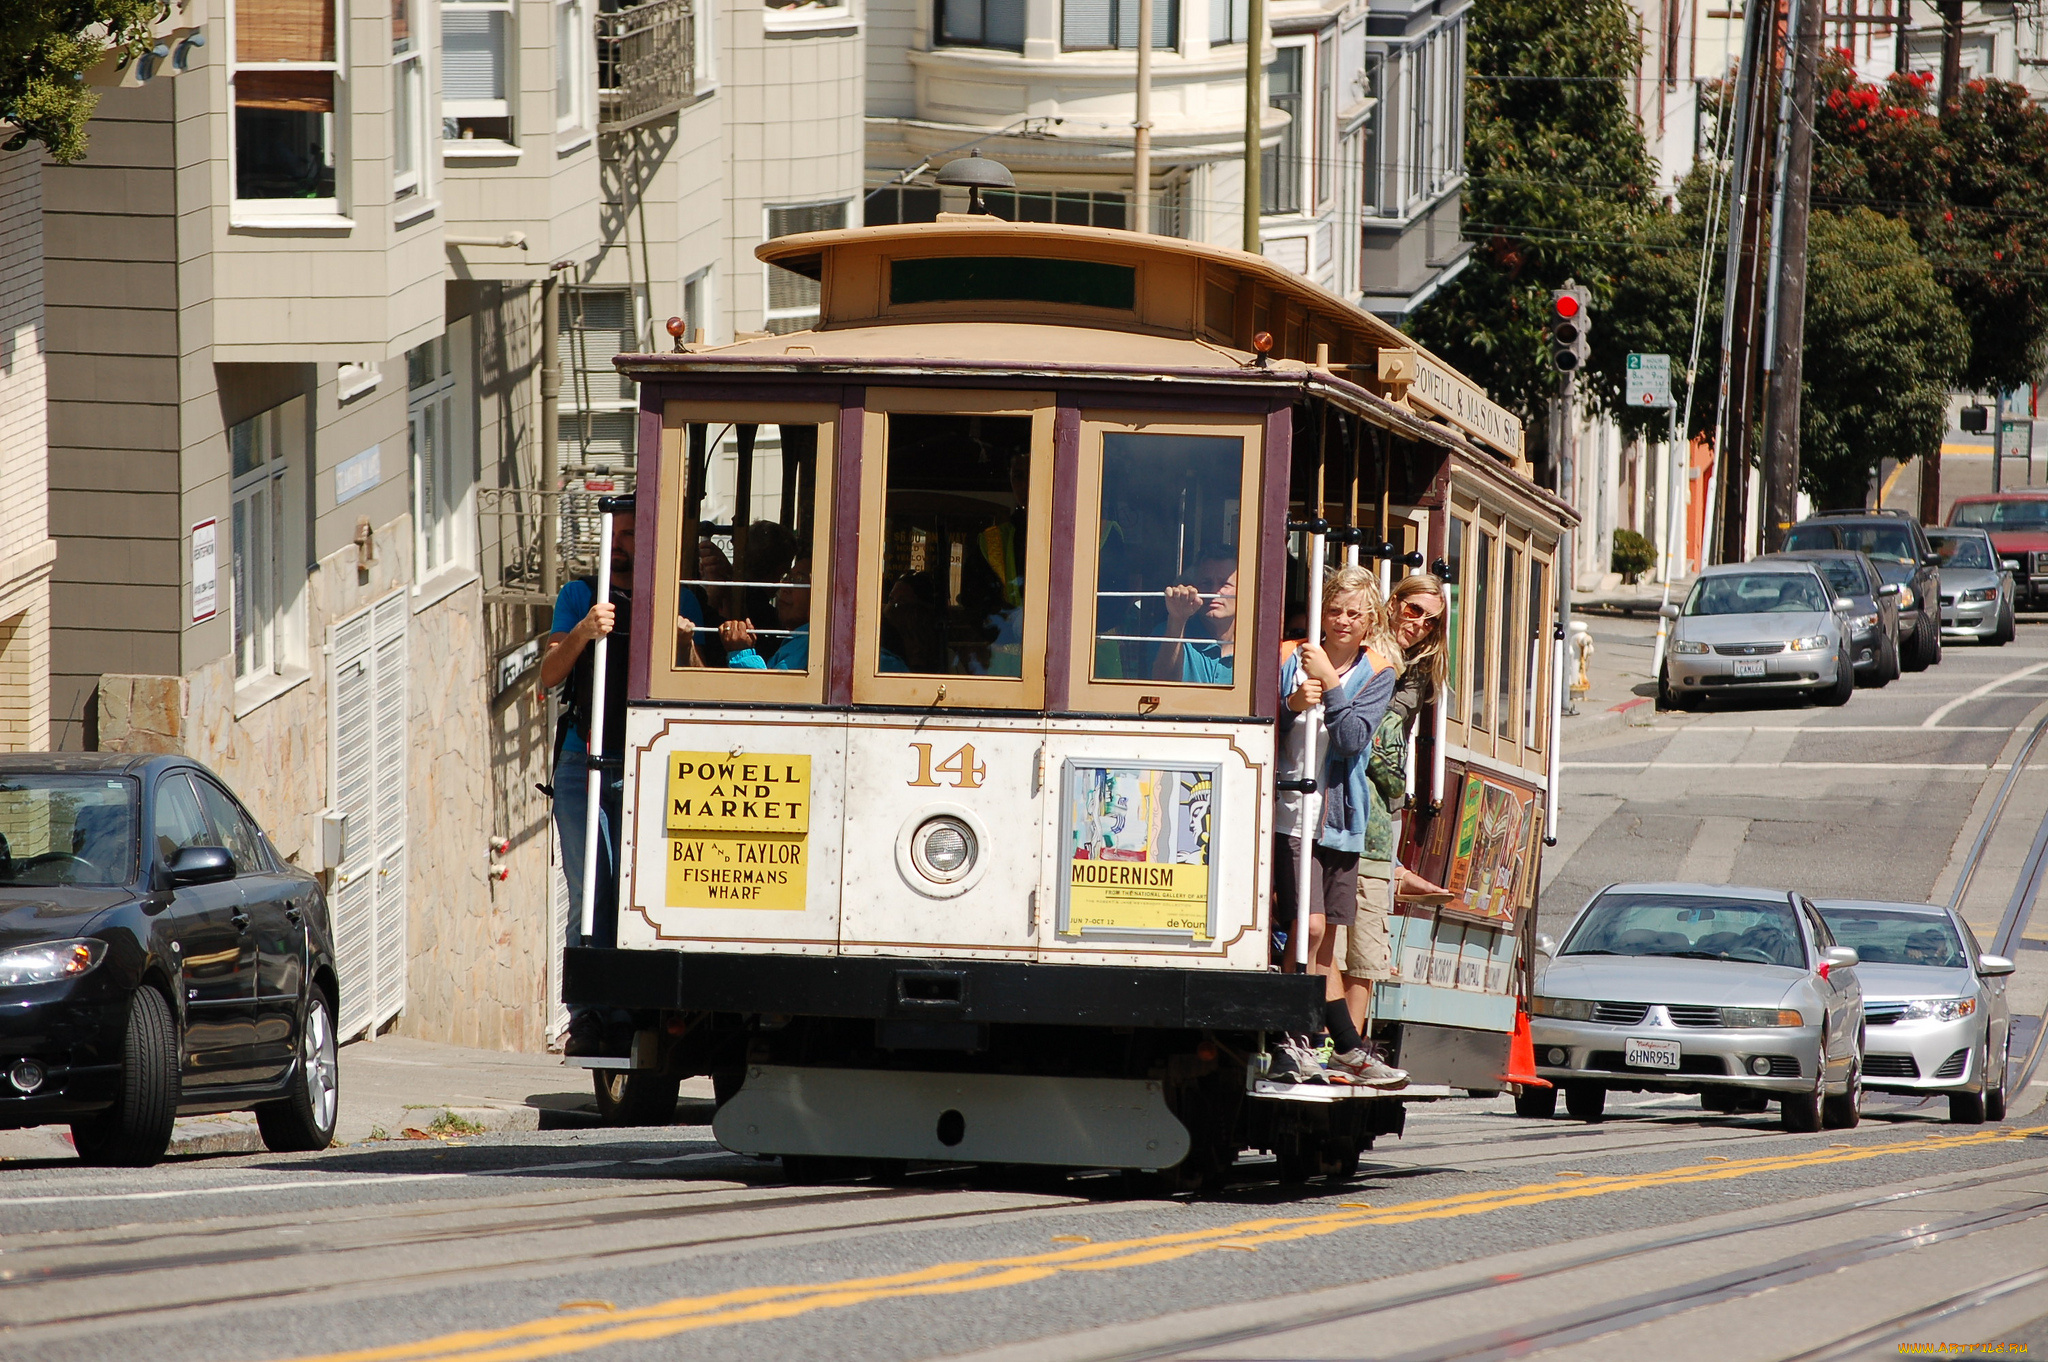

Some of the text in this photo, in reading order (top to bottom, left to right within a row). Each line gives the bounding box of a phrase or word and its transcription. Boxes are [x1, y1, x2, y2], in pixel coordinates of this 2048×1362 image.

[1630, 356, 1639, 368] 2
[1413, 363, 1453, 411] POWELL
[1457, 388, 1463, 418] &
[1467, 394, 1501, 439] MASON
[678, 762, 801, 784] POWELL
[906, 742, 987, 789] 14
[710, 784, 771, 799] AND
[673, 799, 802, 819] MARKET
[673, 841, 801, 865] BAY AND TAYLOR
[683, 868, 788, 885] FISHERMANS
[1072, 864, 1174, 887] MODERNISM
[708, 885, 762, 900] WHARF
[1167, 918, 1206, 929] de Youn
[1629, 1049, 1676, 1066] 6HNR951
